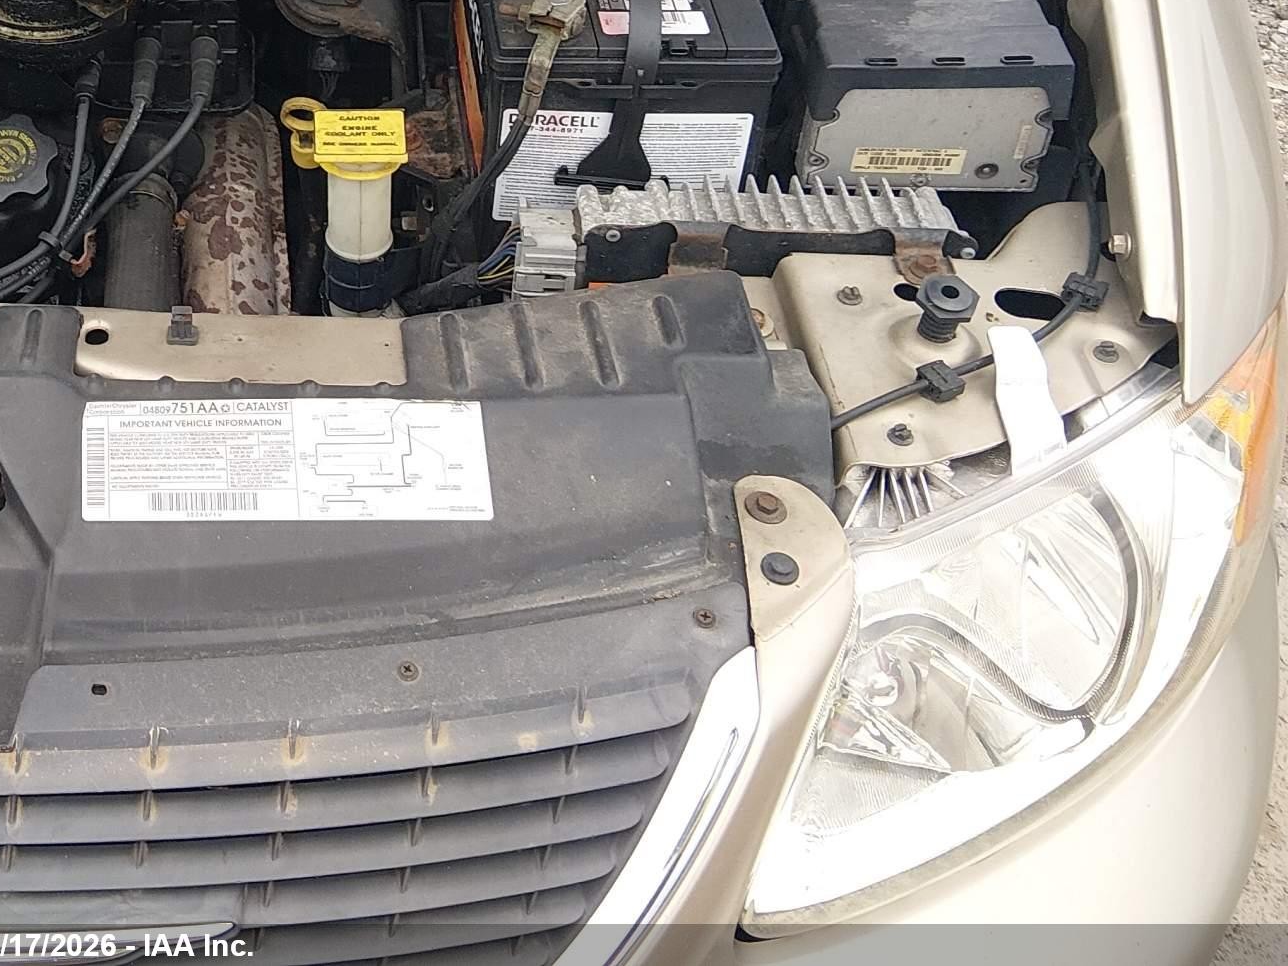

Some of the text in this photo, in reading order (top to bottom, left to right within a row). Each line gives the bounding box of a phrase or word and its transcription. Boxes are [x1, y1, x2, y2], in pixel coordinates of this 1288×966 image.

[508, 113, 599, 128] DRACELL
[236, 402, 289, 412] CATALYST
[119, 420, 173, 428] IMPORTANT
[214, 418, 282, 427] INFORMATION
